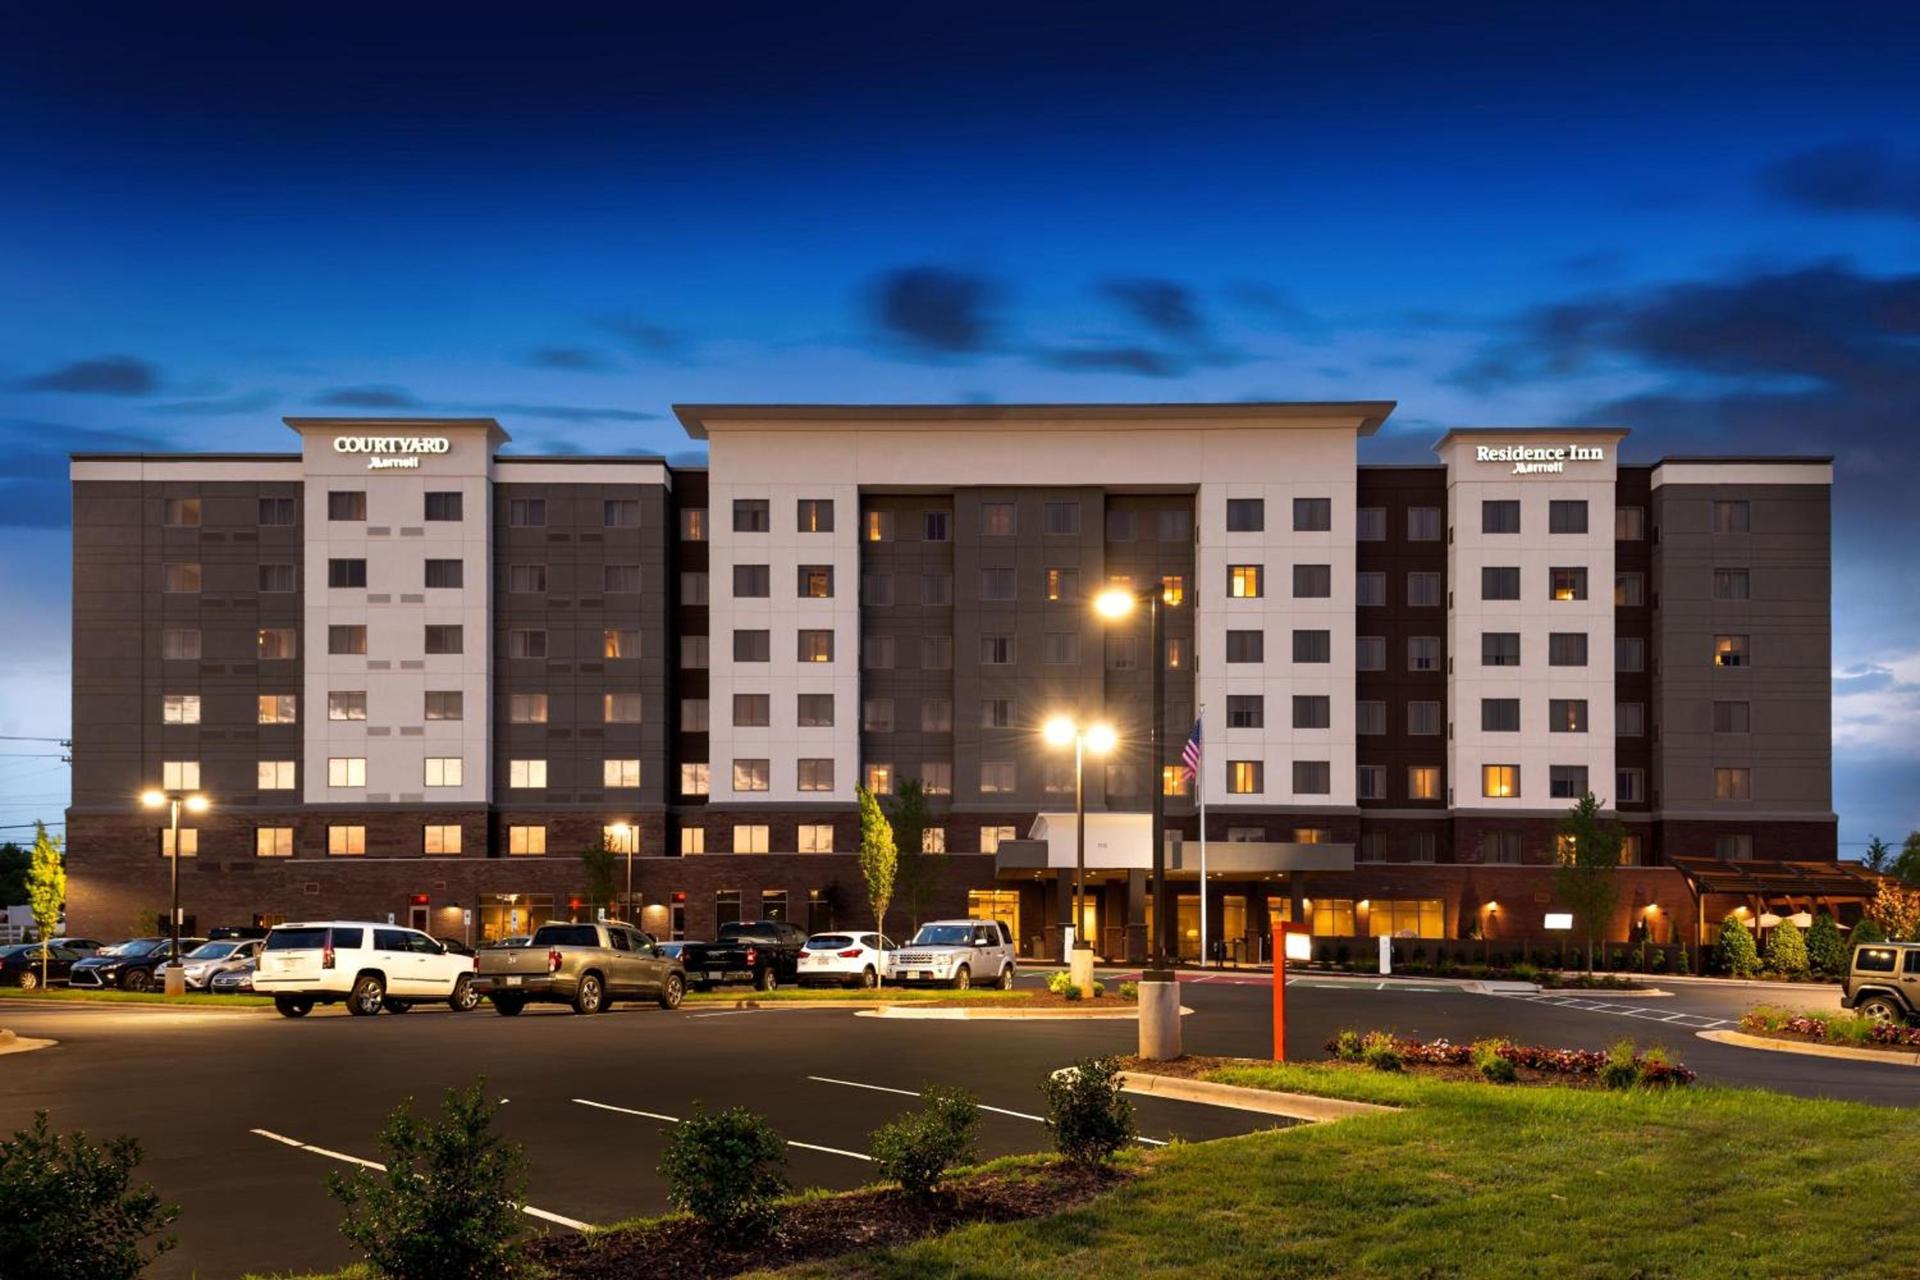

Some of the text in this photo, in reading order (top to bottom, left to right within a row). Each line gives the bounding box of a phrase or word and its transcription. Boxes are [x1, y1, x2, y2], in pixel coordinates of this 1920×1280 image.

[333, 436, 450, 453] COURTYARD
[1476, 444, 1604, 461] Residence Inn
[368, 456, 419, 469] Marriott
[1512, 462, 1564, 474] Marriott
